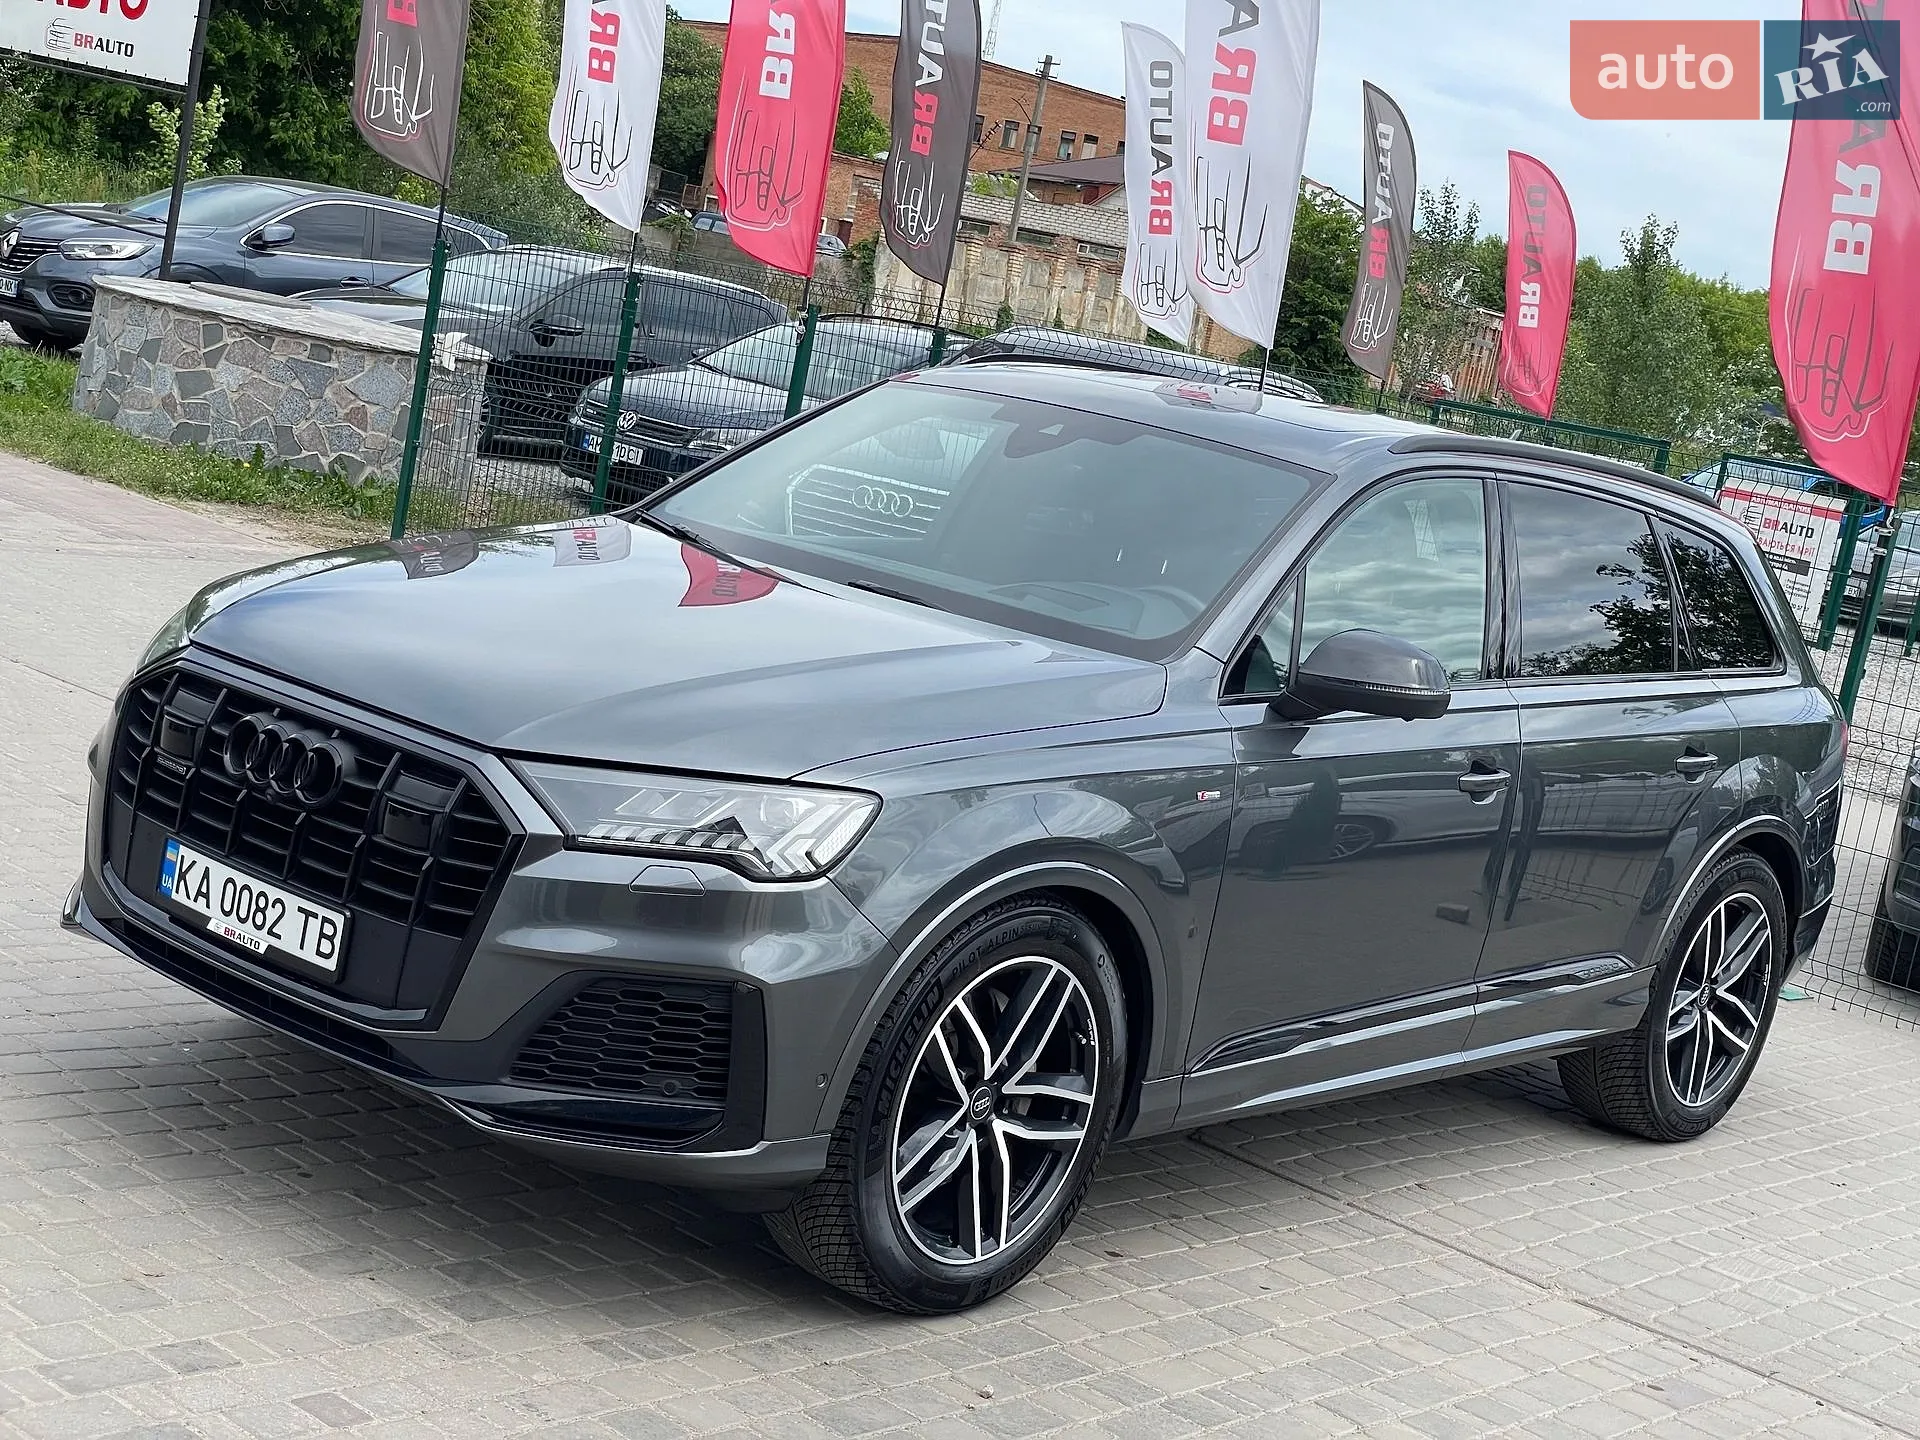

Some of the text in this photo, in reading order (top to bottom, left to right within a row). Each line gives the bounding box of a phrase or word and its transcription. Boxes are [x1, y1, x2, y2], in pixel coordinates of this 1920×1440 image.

[73, 32, 135, 58] BRAUTO
[1762, 517, 1815, 539] BRAUTO
[162, 873, 173, 890] UA
[175, 854, 338, 961] KA 0082 TB
[223, 926, 261, 951] BRAUTO
[951, 945, 981, 978] PILOT
